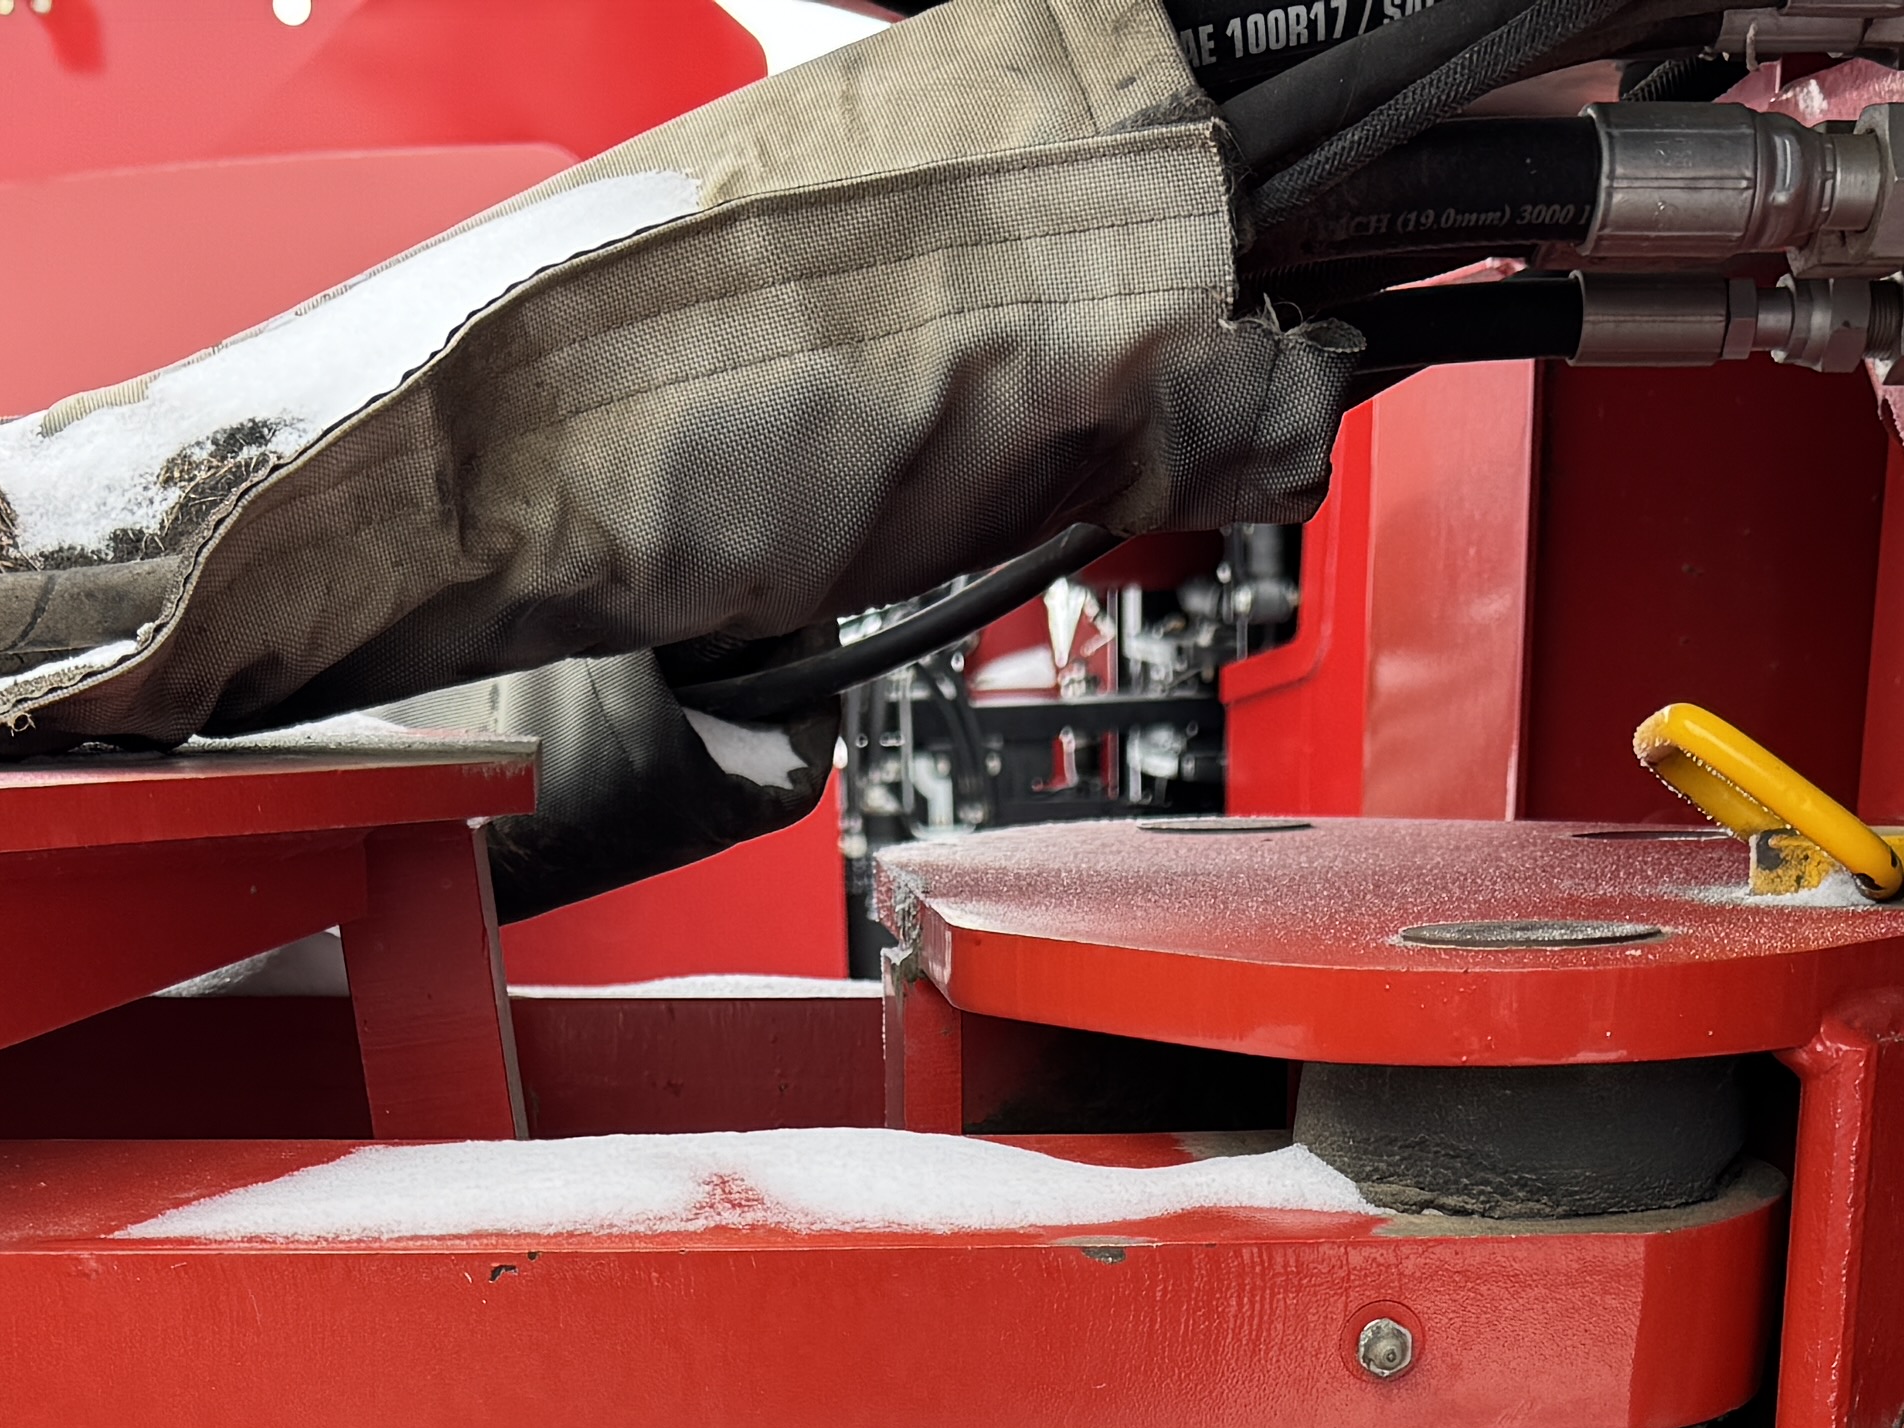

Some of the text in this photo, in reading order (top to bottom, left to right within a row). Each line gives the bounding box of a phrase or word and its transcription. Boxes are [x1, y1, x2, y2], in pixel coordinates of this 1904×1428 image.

[1225, 0, 1348, 58] 100R17
[1396, 205, 1511, 236] (19.0mm)
[1515, 203, 1574, 226] 3000
